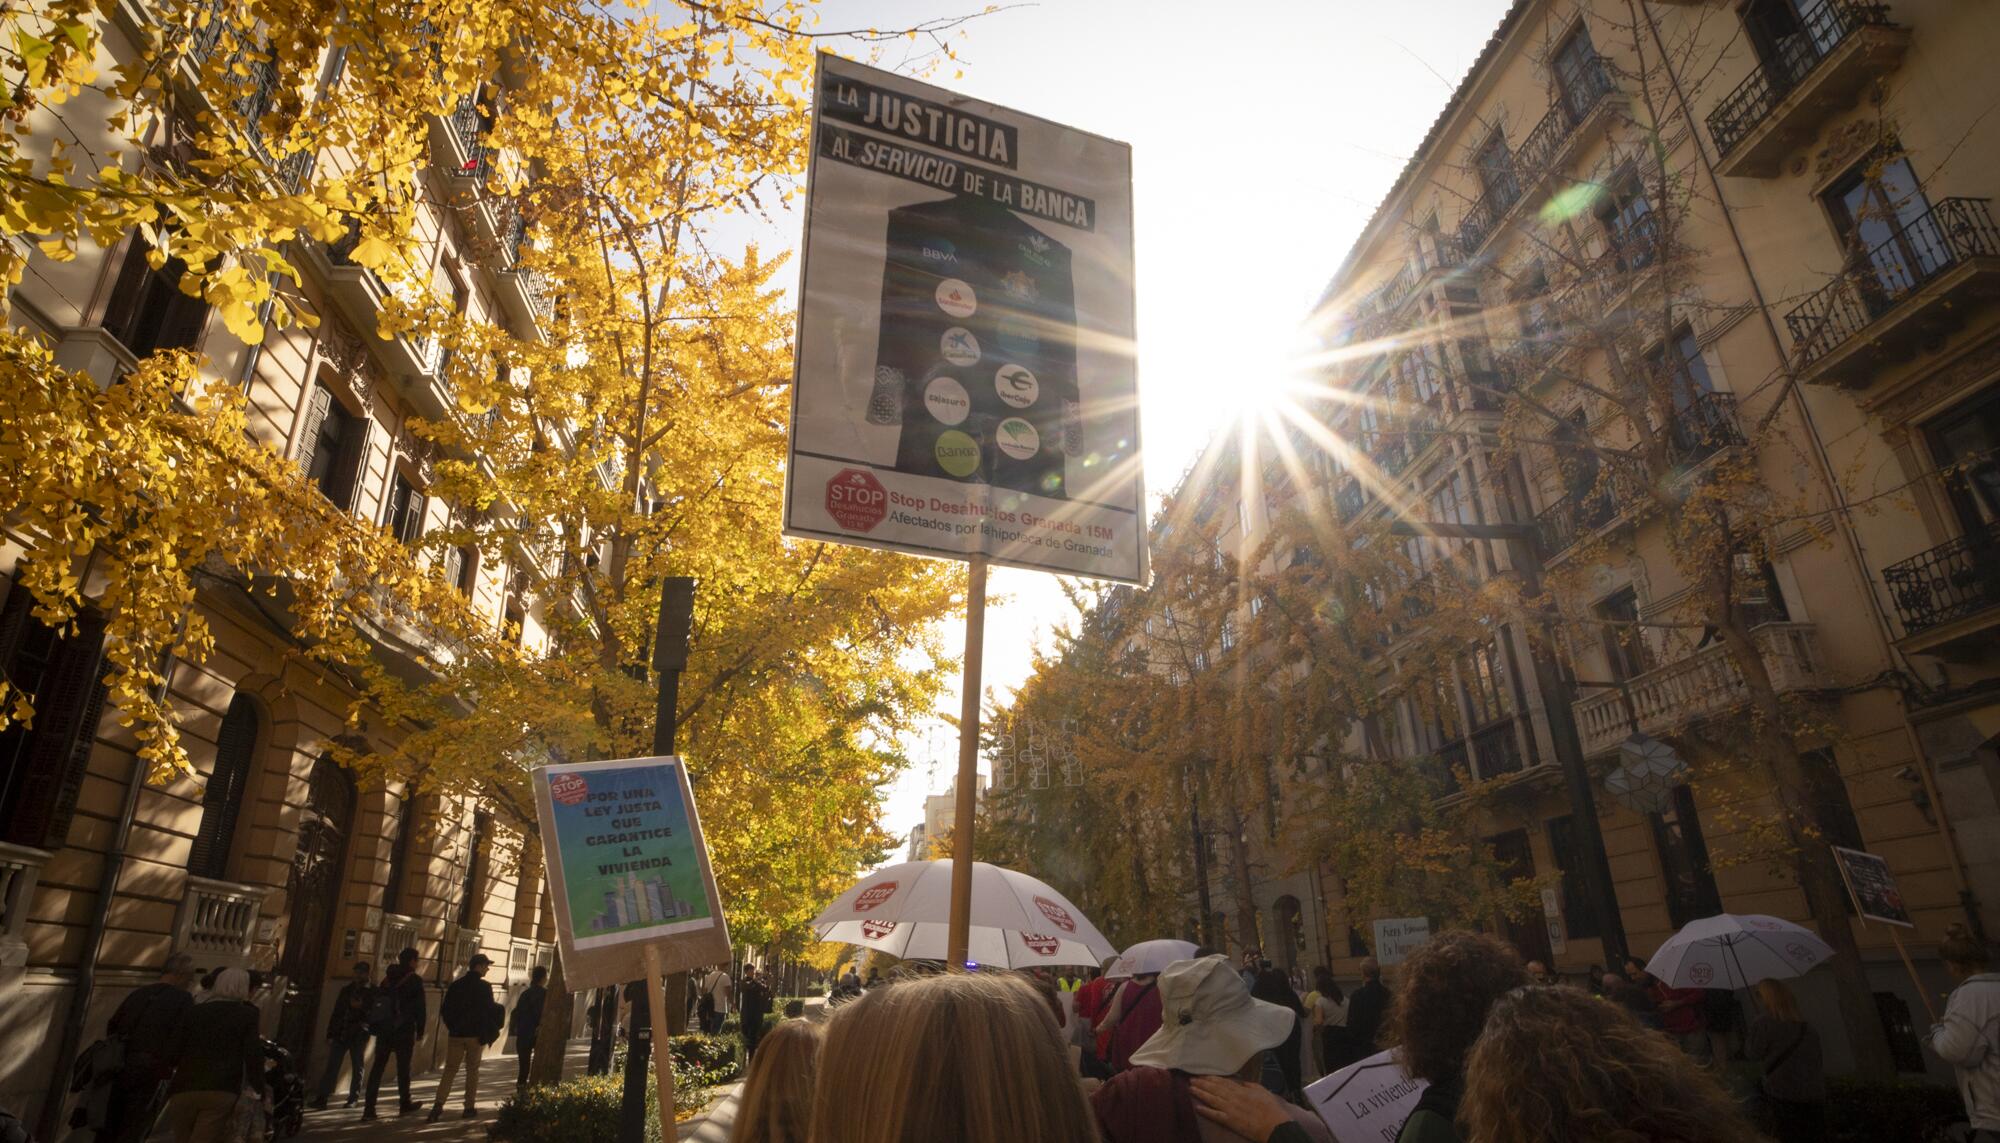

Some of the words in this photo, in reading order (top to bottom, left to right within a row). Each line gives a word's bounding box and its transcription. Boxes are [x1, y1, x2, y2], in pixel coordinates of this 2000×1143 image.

[837, 84, 859, 108] LA
[864, 92, 1010, 163] JUSTICIA
[832, 137, 854, 162] AL
[860, 141, 958, 188] SERVICIO
[963, 171, 984, 197] DE
[993, 180, 1013, 205] LA
[1020, 184, 1089, 227] BANCA
[922, 247, 959, 265] BBVA
[831, 484, 884, 506] STOP
[889, 491, 926, 512] Stop
[1021, 512, 1082, 536] Granada
[1085, 525, 1114, 541] 15M
[889, 510, 953, 532] Afectados
[955, 523, 977, 537] por
[1045, 537, 1061, 549] de
[1064, 539, 1114, 559] Granada
[552, 779, 584, 794] STOP
[587, 792, 619, 803] POR
[623, 788, 656, 801] UNA
[584, 806, 612, 817] LEY
[616, 801, 662, 815] JUSTA
[611, 817, 642, 830] QUE
[585, 827, 673, 847] GARANTICE
[623, 847, 642, 858] LA
[598, 856, 673, 876] VIVIENDA
[1345, 1099, 1372, 1120] La
[1368, 1075, 1420, 1110] vivienda
